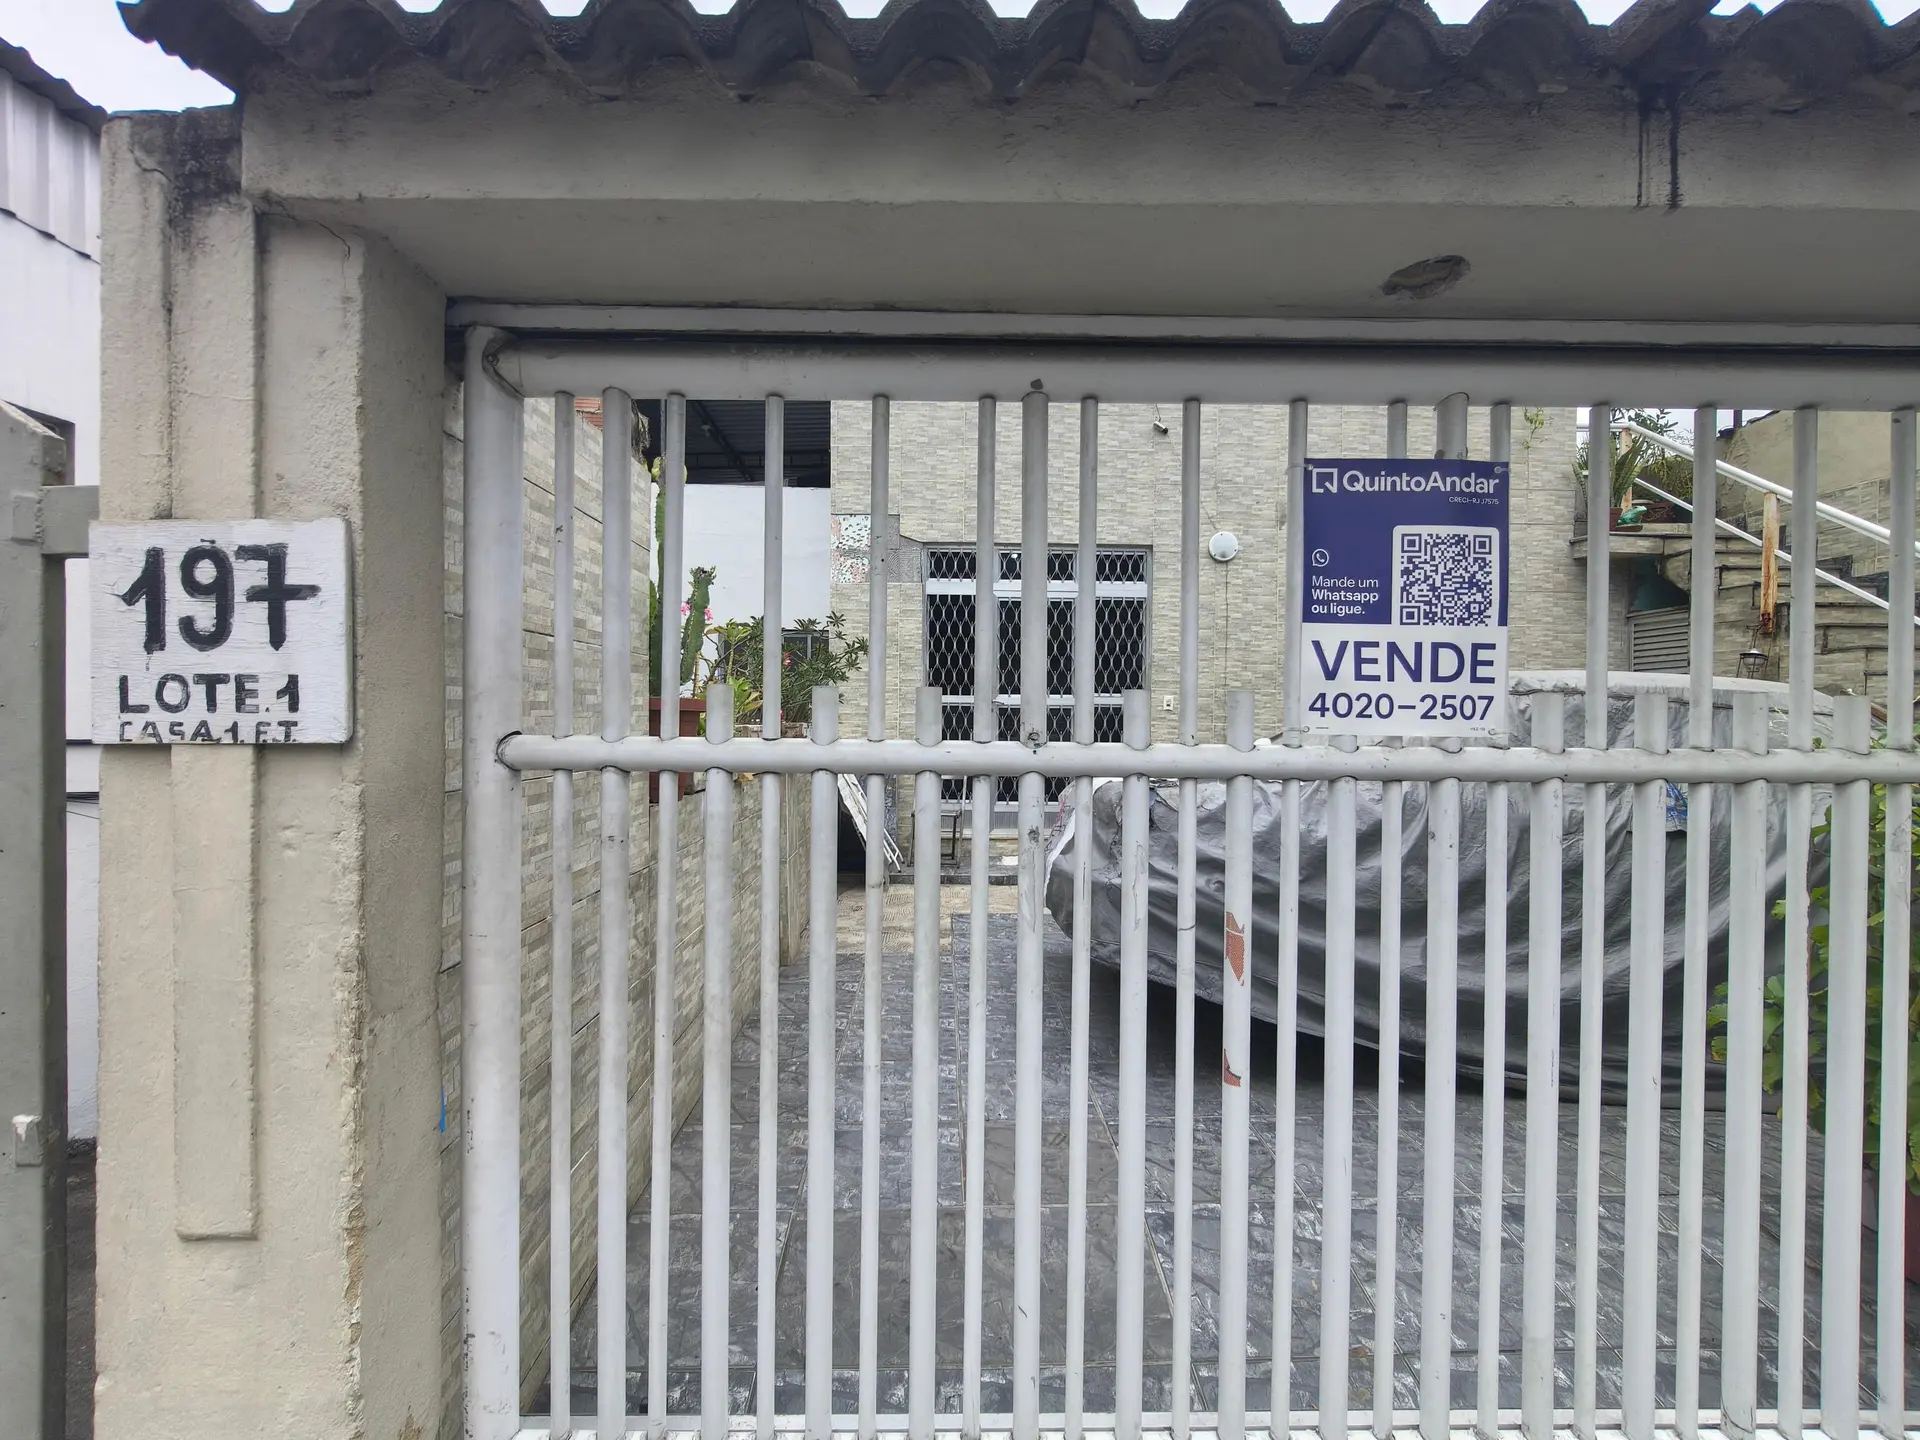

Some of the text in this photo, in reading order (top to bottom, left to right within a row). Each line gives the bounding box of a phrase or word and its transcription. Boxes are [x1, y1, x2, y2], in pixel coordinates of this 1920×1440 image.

[1343, 470, 1499, 494] QuintoAndar
[1448, 496, 1480, 504] CRECI-RJ
[1312, 575, 1379, 588] Mande um
[120, 542, 322, 654] 197
[1311, 588, 1379, 604] Whatsapp
[1311, 602, 1366, 617] ou ligue.
[1310, 640, 1497, 684] VENDE
[1308, 692, 1495, 721] 4020-2507
